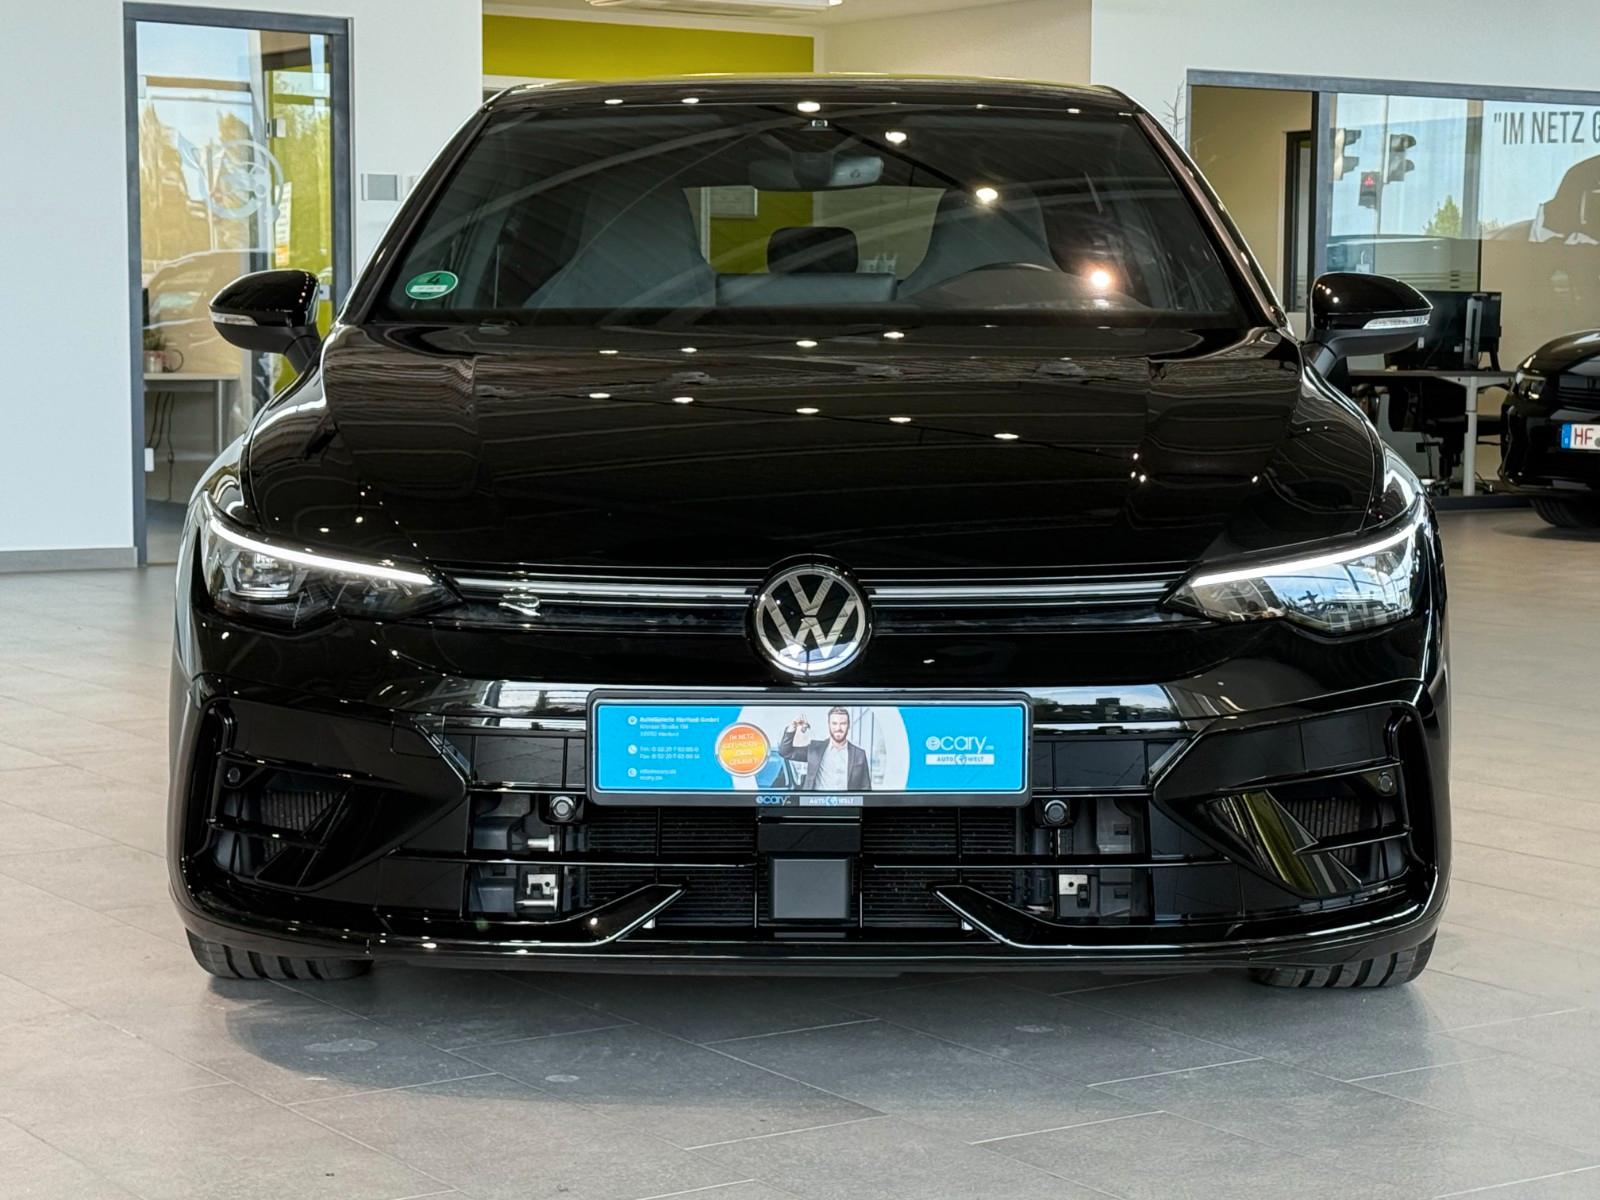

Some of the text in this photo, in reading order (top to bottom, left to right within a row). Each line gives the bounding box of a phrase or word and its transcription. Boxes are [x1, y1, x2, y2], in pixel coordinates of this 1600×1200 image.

[1494, 112, 1524, 145] "IM
[1531, 111, 1585, 144] NETZ
[761, 571, 862, 661] VW
